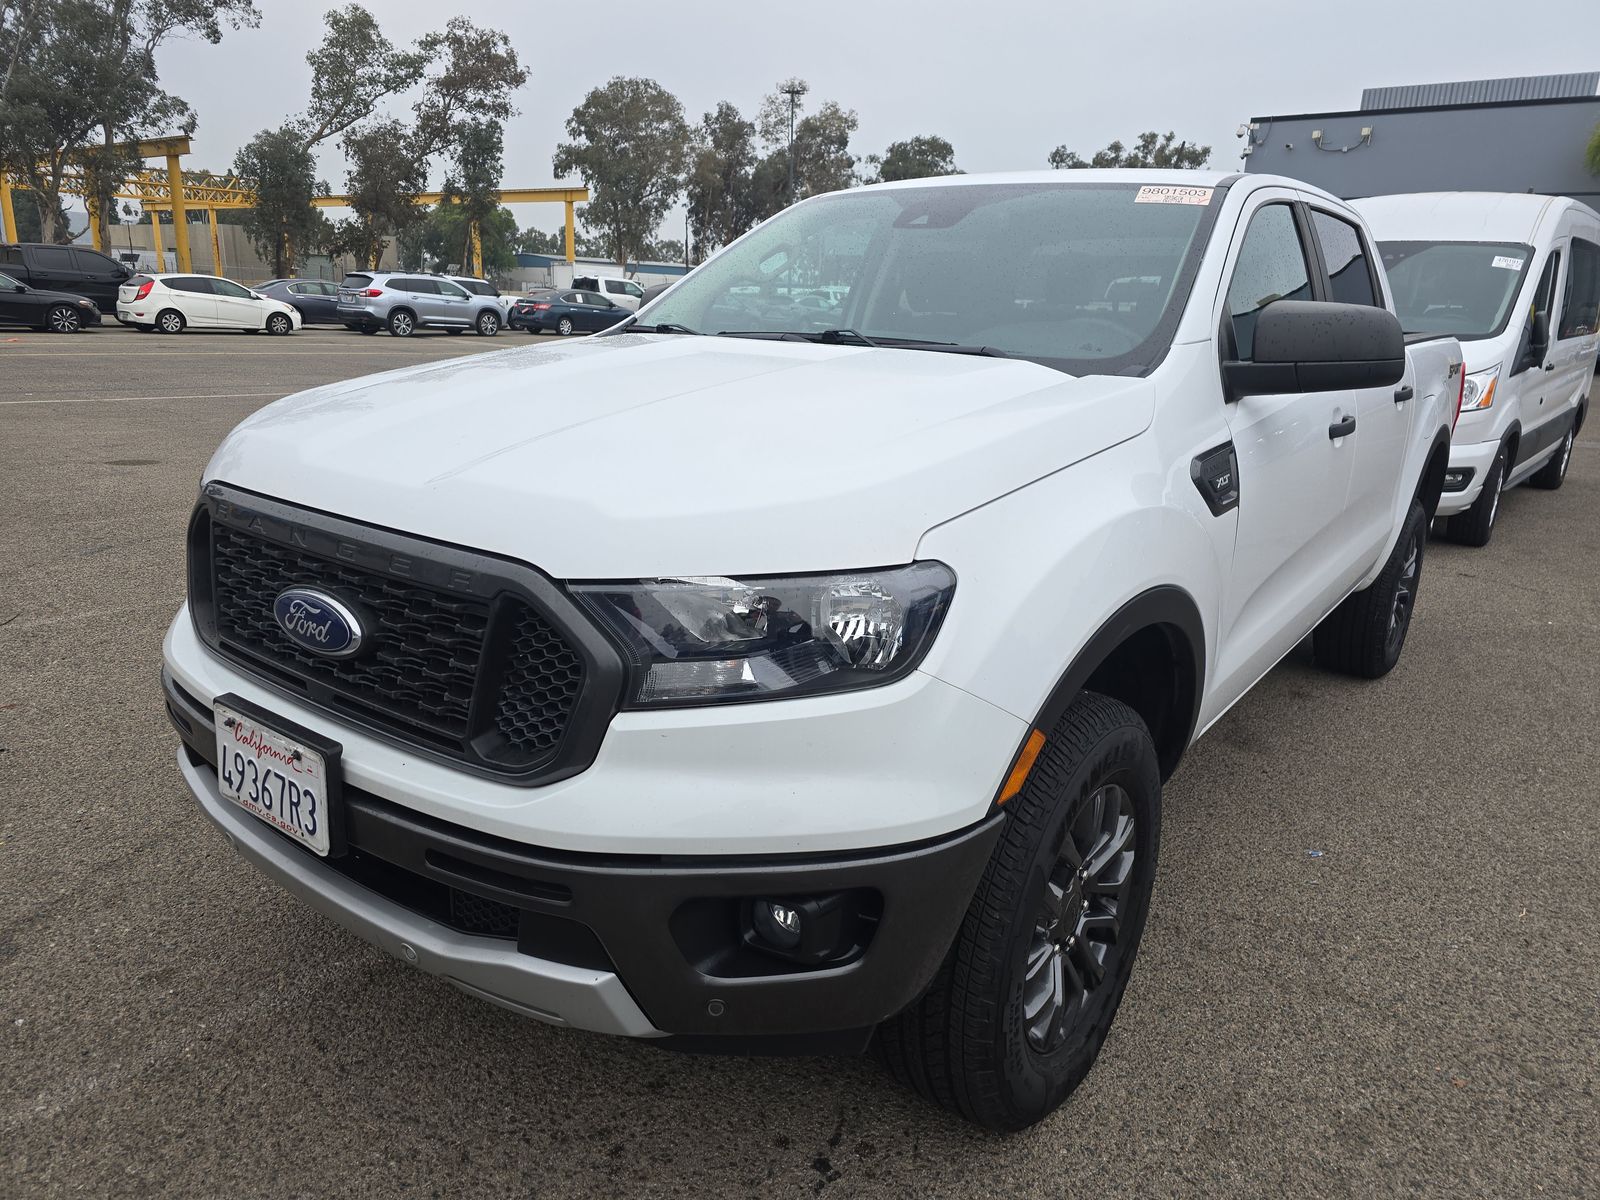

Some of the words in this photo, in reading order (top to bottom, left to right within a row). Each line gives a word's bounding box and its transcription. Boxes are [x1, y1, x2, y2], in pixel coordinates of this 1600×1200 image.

[1142, 187, 1207, 197] 9801503
[1216, 473, 1230, 489] XLT
[215, 501, 473, 593] RANGER
[285, 599, 331, 643] Ford
[234, 721, 302, 774] California
[222, 744, 317, 836] 49367R3
[242, 799, 299, 835] dmv.ca.gov
